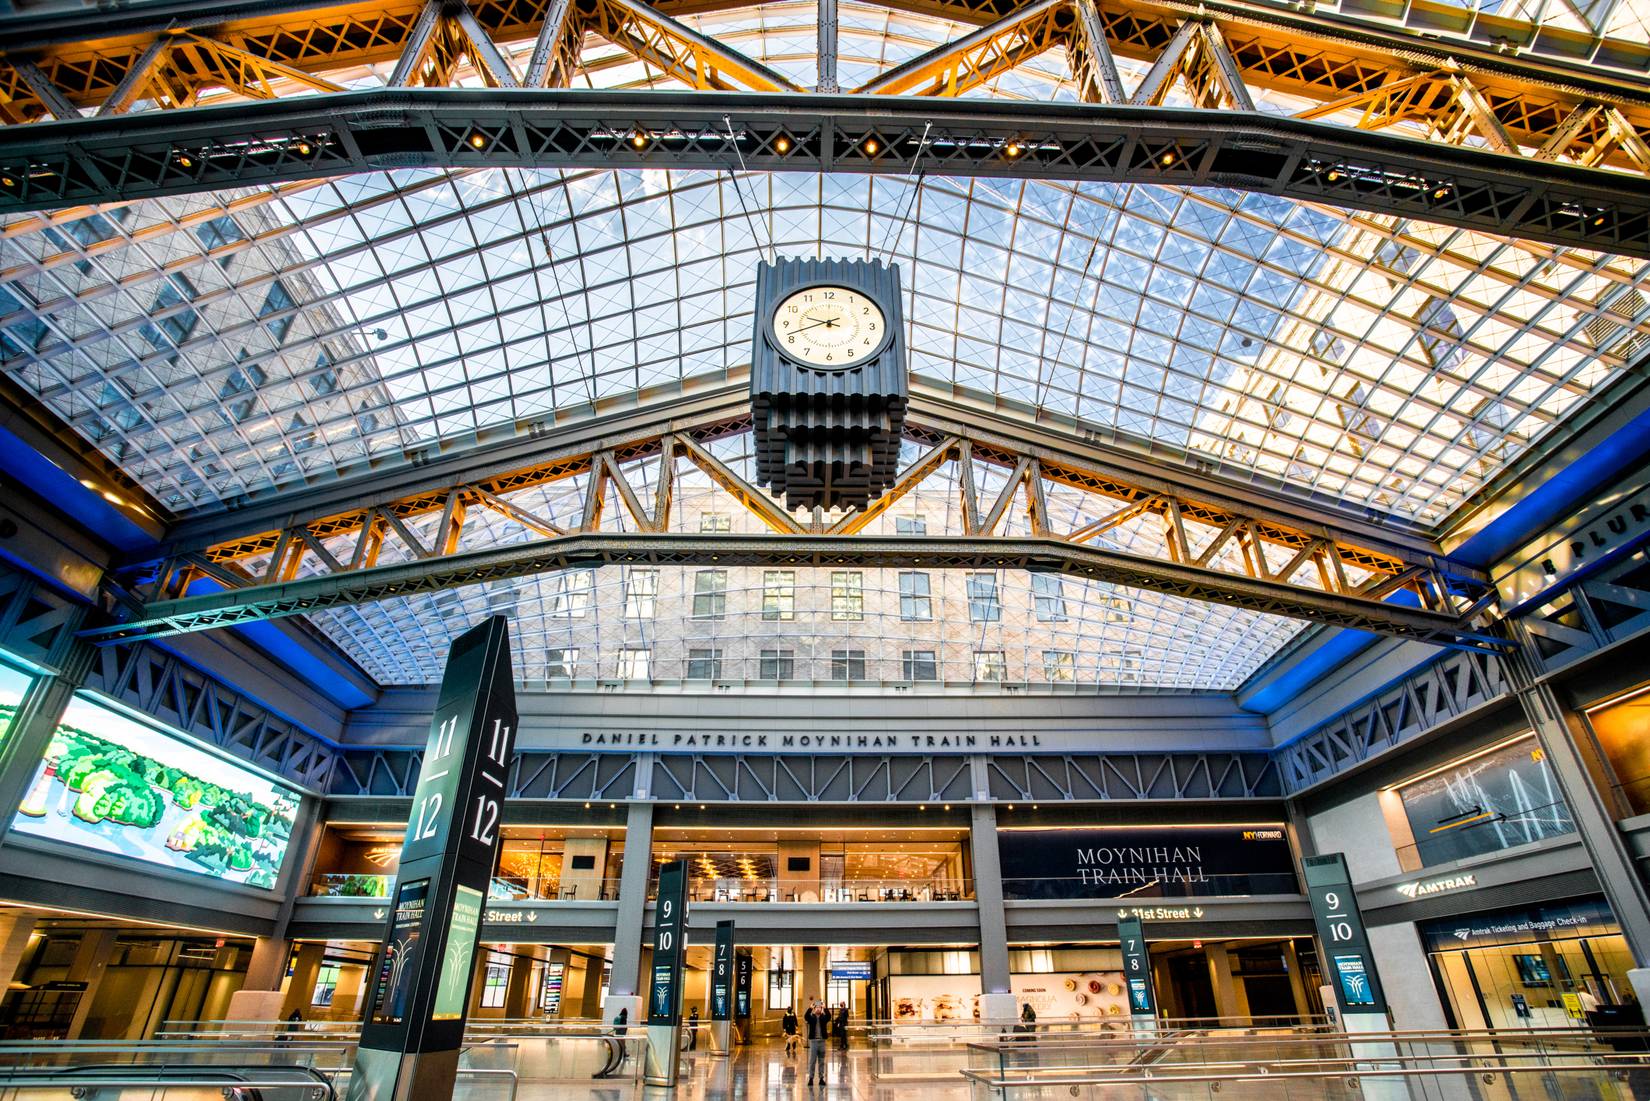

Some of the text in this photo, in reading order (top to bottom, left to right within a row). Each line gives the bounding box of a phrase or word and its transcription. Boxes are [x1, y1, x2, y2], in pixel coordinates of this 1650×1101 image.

[788, 305, 798, 313] 10
[863, 307, 870, 315] 2
[783, 320, 789, 328] 9
[869, 322, 876, 331] 3
[788, 335, 795, 344] 8
[863, 337, 870, 345] 4
[804, 347, 811, 356] 7
[826, 352, 833, 361] 6
[847, 348, 854, 357] 5
[431, 714, 458, 762] 11
[487, 718, 510, 768] 11
[582, 733, 1041, 747] DANIEL PATRICK MOYNIHAN TRAIN HALL
[412, 792, 443, 842] 12
[469, 794, 498, 847] 12
[1077, 847, 1201, 865] MOYNIHAN
[1077, 866, 1210, 885] TRAIN HALL
[1418, 875, 1477, 895] AMTRAK
[1325, 892, 1340, 910] 9
[664, 901, 672, 918] 9
[1156, 908, 1190, 919] Street
[488, 911, 522, 921] Street
[1330, 922, 1353, 941] 10
[1472, 928, 1491, 936] Amtrak
[1491, 924, 1518, 933] Ticketing
[1517, 922, 1529, 930] and
[1529, 919, 1556, 930] Baggage
[1557, 915, 1588, 926] Check-in
[659, 932, 672, 950] 10
[1128, 940, 1135, 952] 7
[720, 944, 726, 957] 7
[718, 963, 725, 976] 8
[741, 961, 747, 971] 5
[1131, 959, 1140, 970] 8
[740, 975, 746, 985] 6
